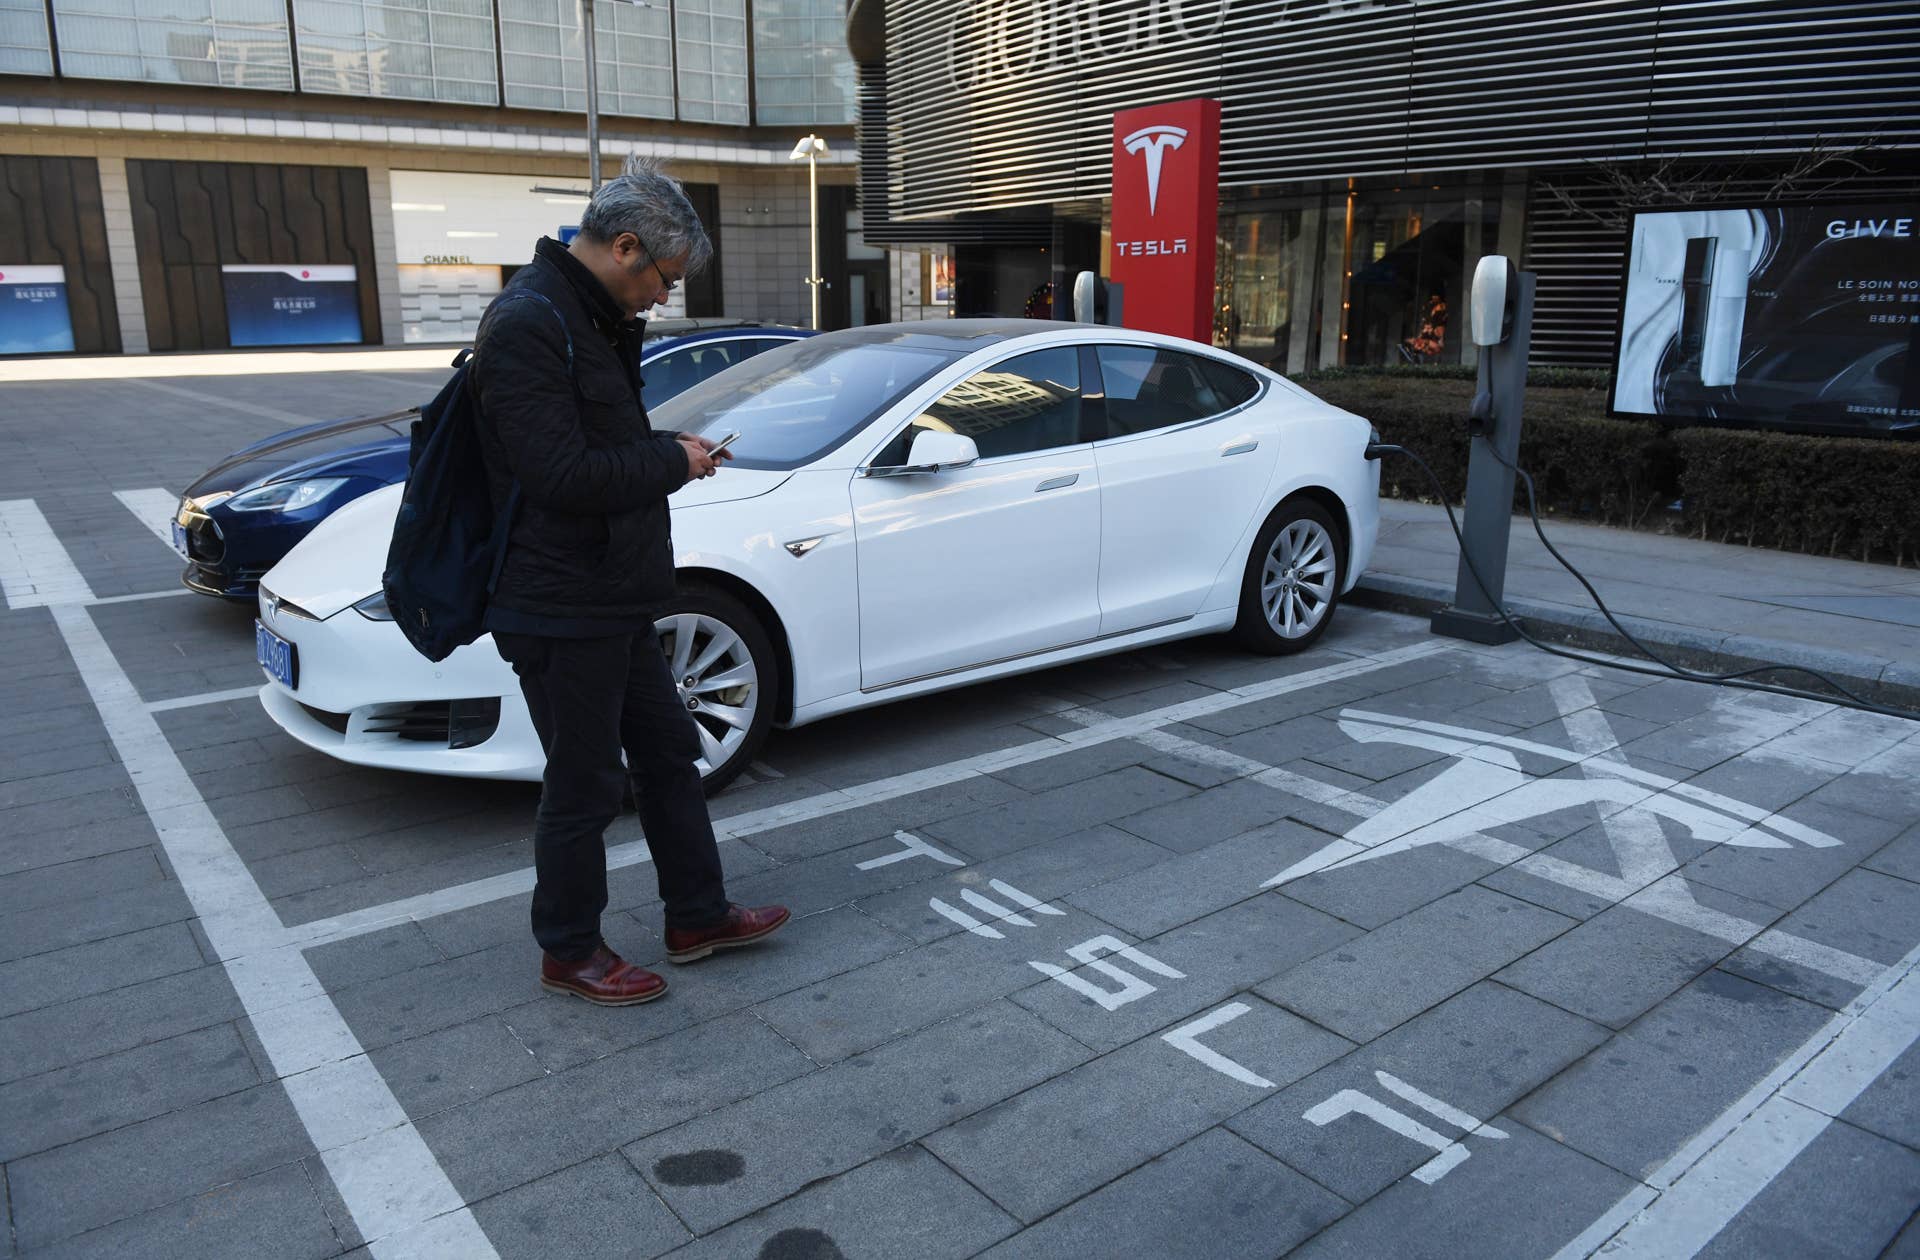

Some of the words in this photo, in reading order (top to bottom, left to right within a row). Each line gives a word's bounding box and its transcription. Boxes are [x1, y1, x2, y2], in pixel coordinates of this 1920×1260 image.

[1826, 219, 1920, 239] GIVE
[1116, 239, 1187, 256] TESLA
[423, 255, 473, 265] CHANEL
[1838, 280, 1854, 289] LE
[1859, 280, 1893, 289] SOIN
[1898, 280, 1920, 289] NO
[855, 830, 1511, 1184] TESLA
